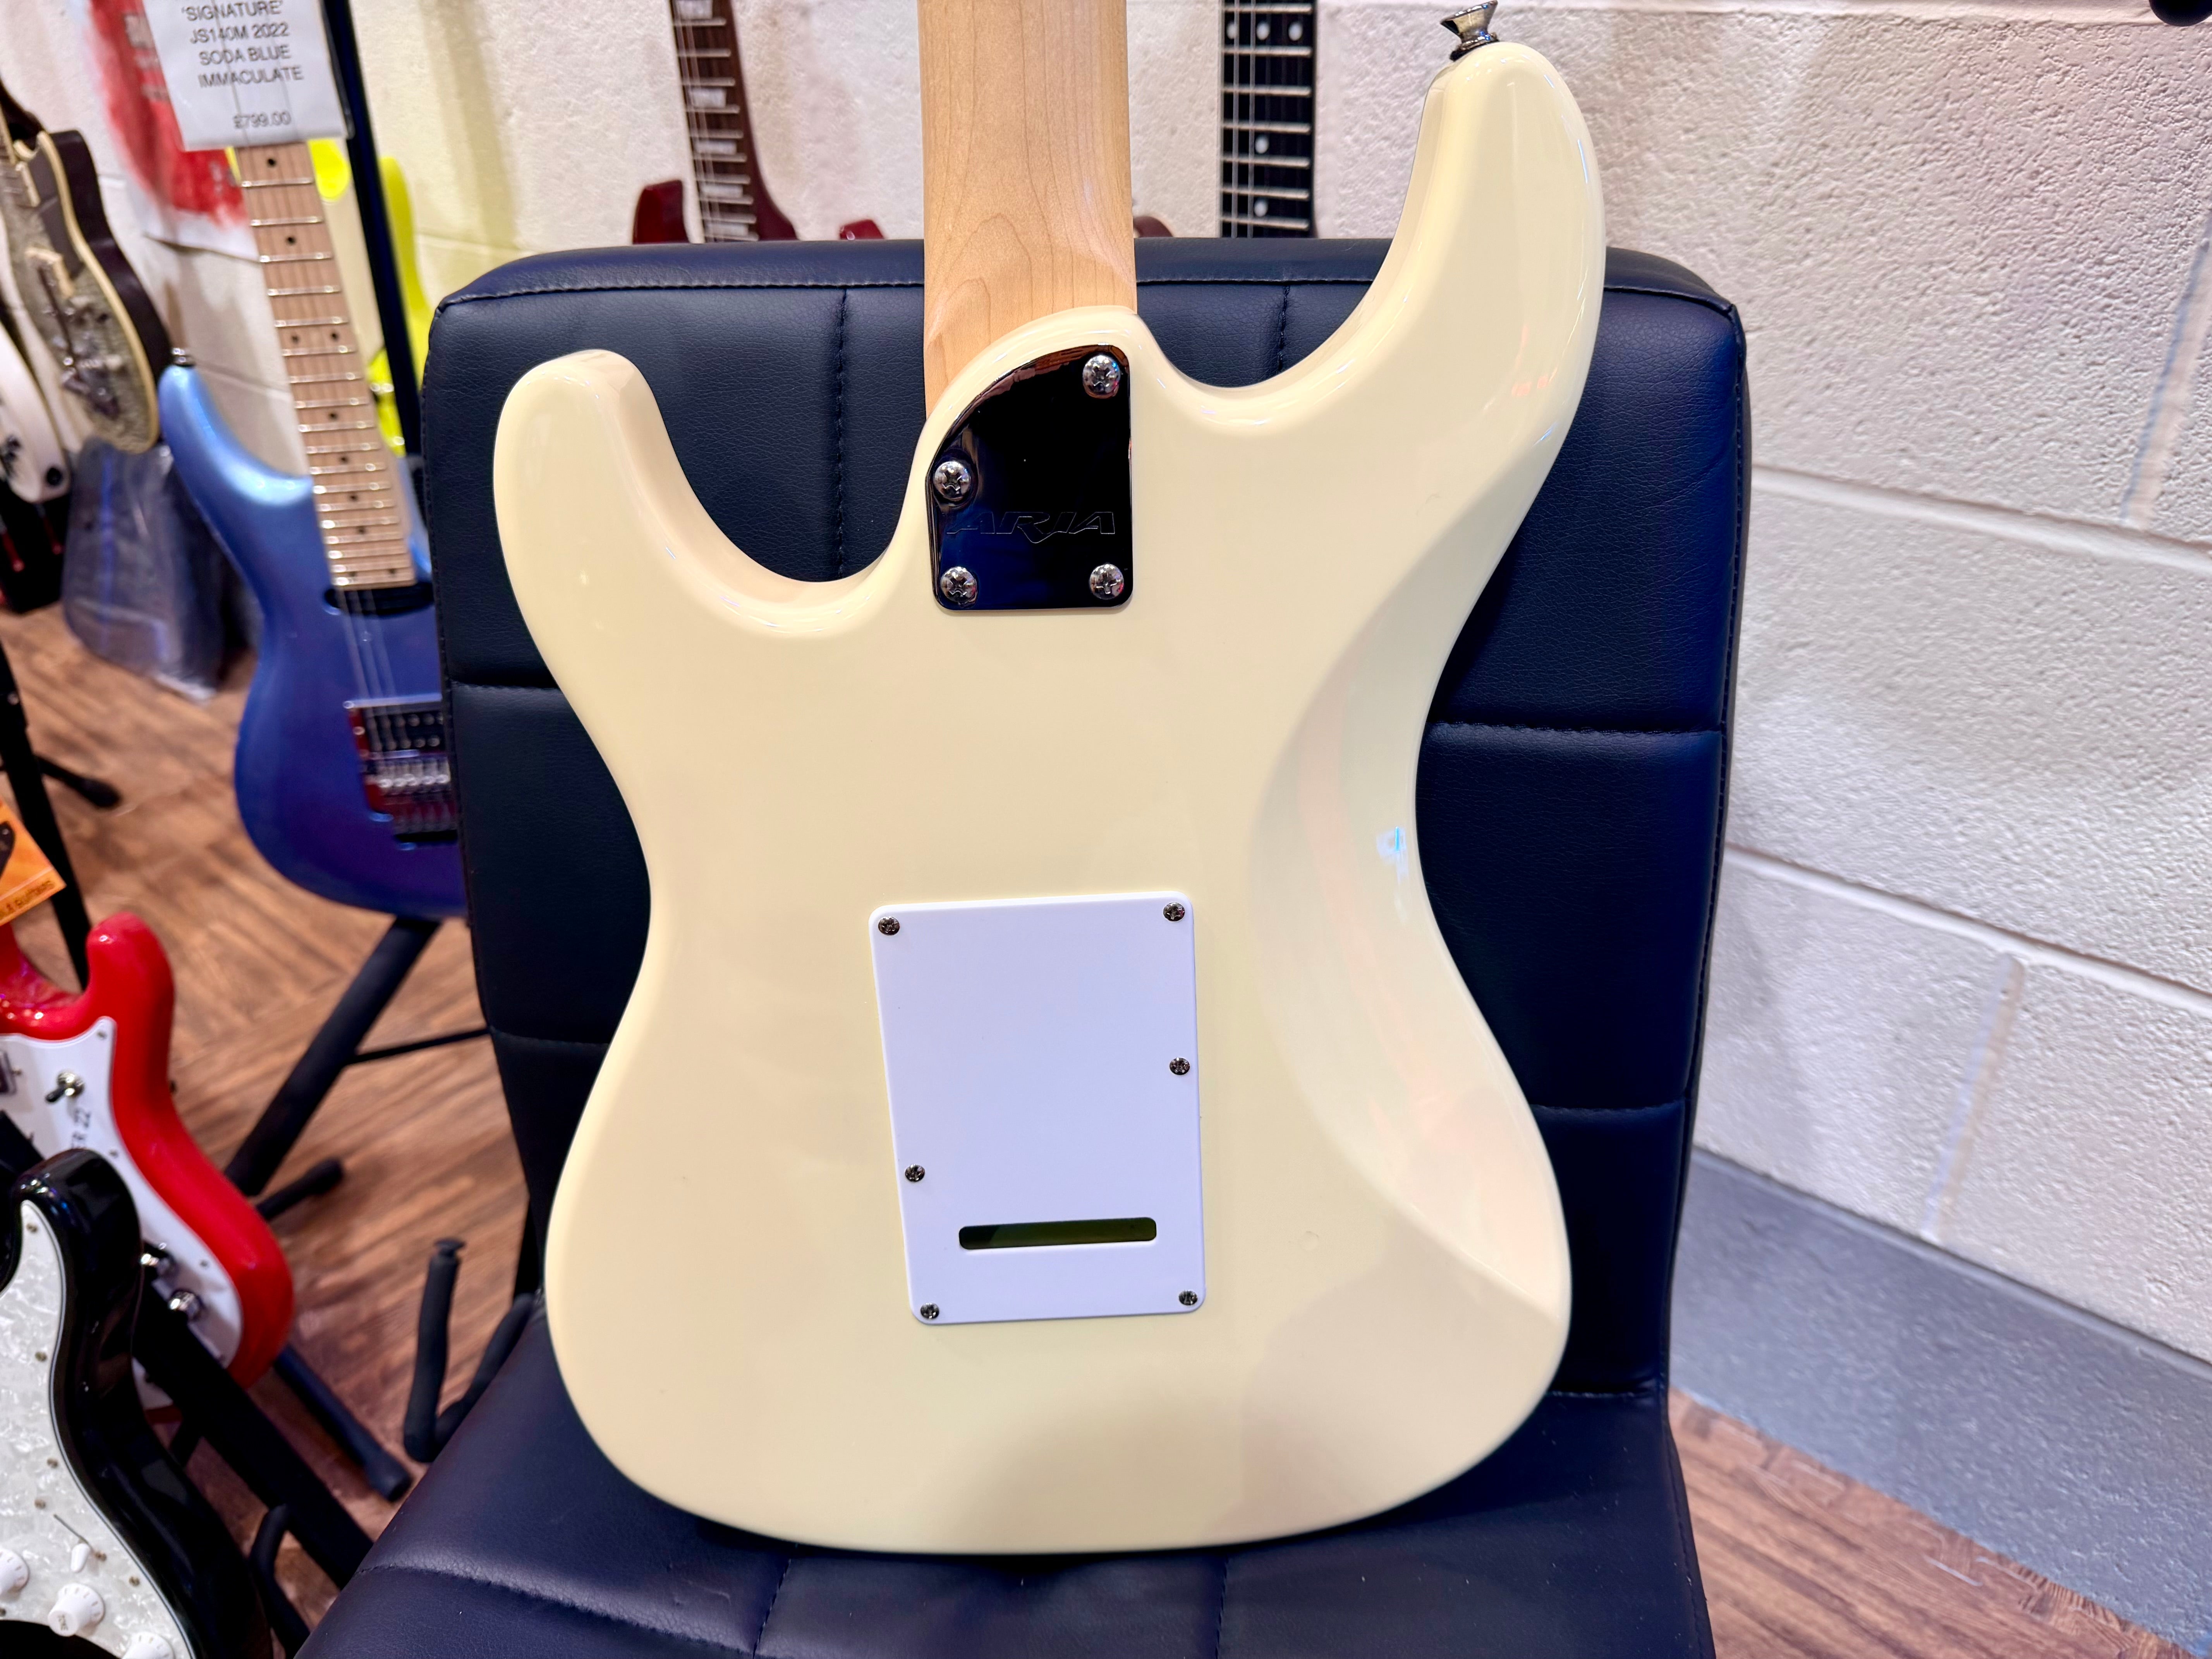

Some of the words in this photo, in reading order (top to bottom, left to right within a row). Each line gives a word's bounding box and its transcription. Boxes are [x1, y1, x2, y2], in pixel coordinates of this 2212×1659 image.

[190, 25, 248, 44] JS140M
[252, 21, 289, 39] 2022
[199, 48, 246, 65] SODA
[247, 44, 291, 61] BLUE
[198, 65, 304, 88] IMMACULATE
[946, 512, 1115, 543] ARIA
